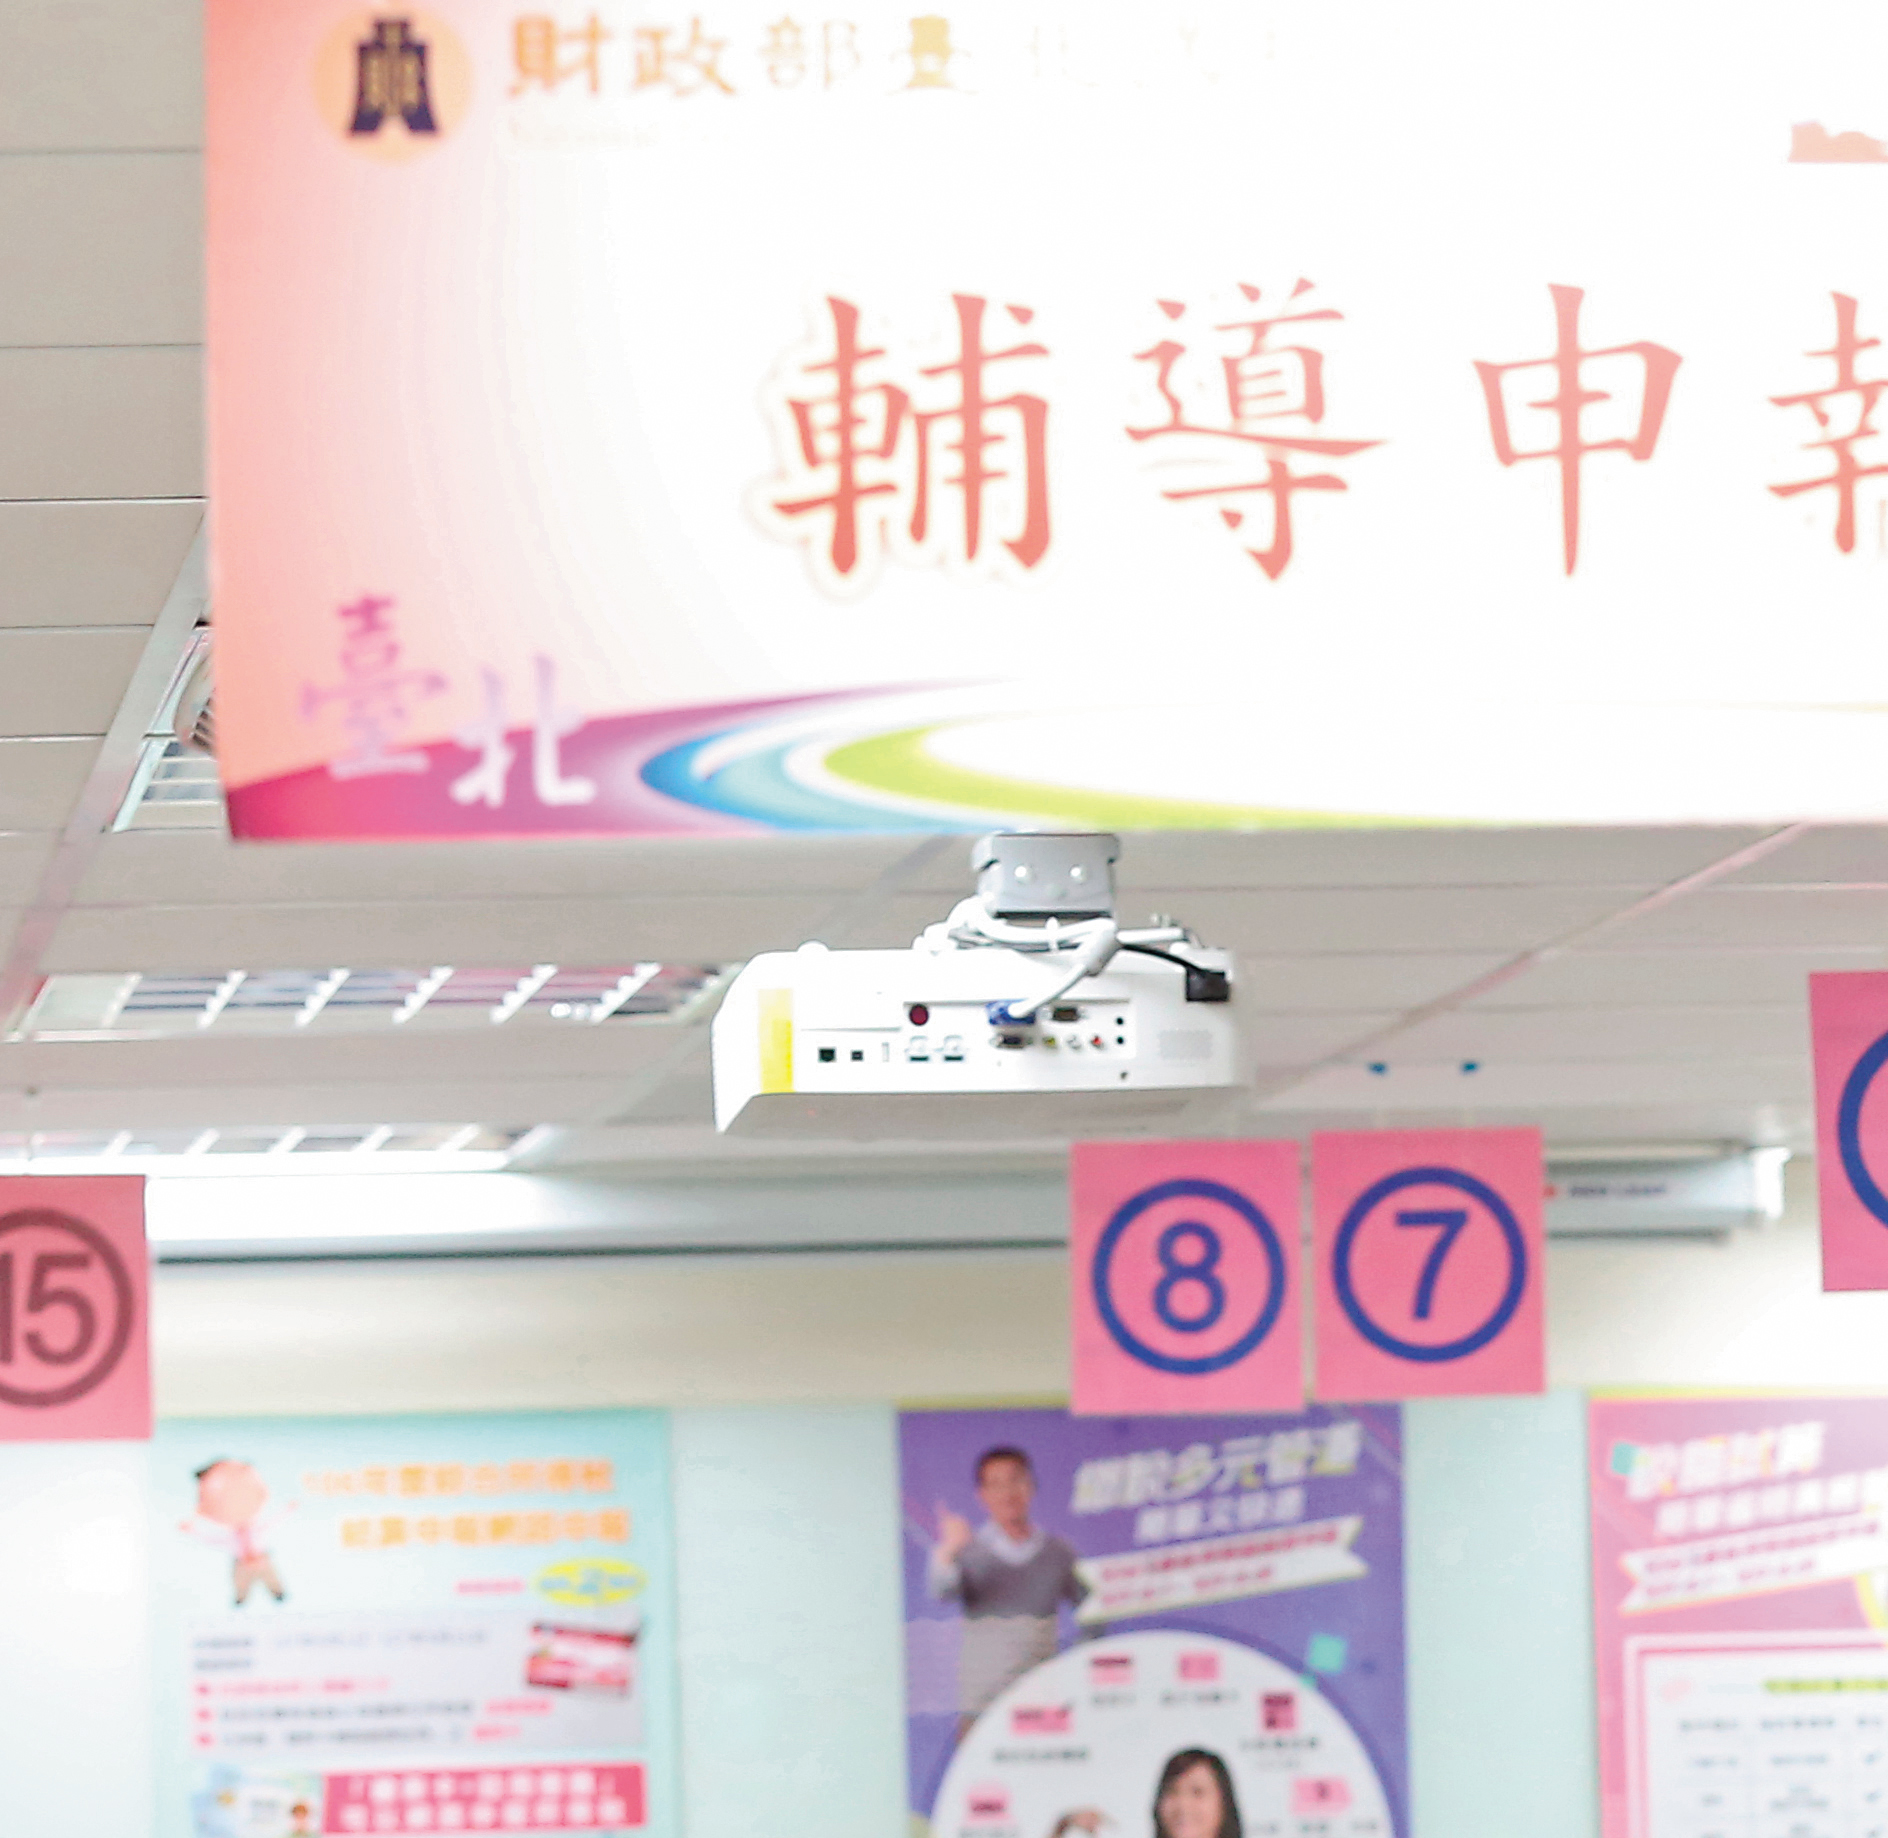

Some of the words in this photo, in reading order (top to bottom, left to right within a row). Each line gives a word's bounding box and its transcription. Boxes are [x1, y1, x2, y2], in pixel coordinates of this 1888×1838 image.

[510, 12, 1095, 98] 財政部臺
[298, 592, 596, 812] 臺北
[0, 1251, 97, 1367] 15
[1151, 1219, 1228, 1335] 8
[1393, 1209, 1469, 1321] 7
